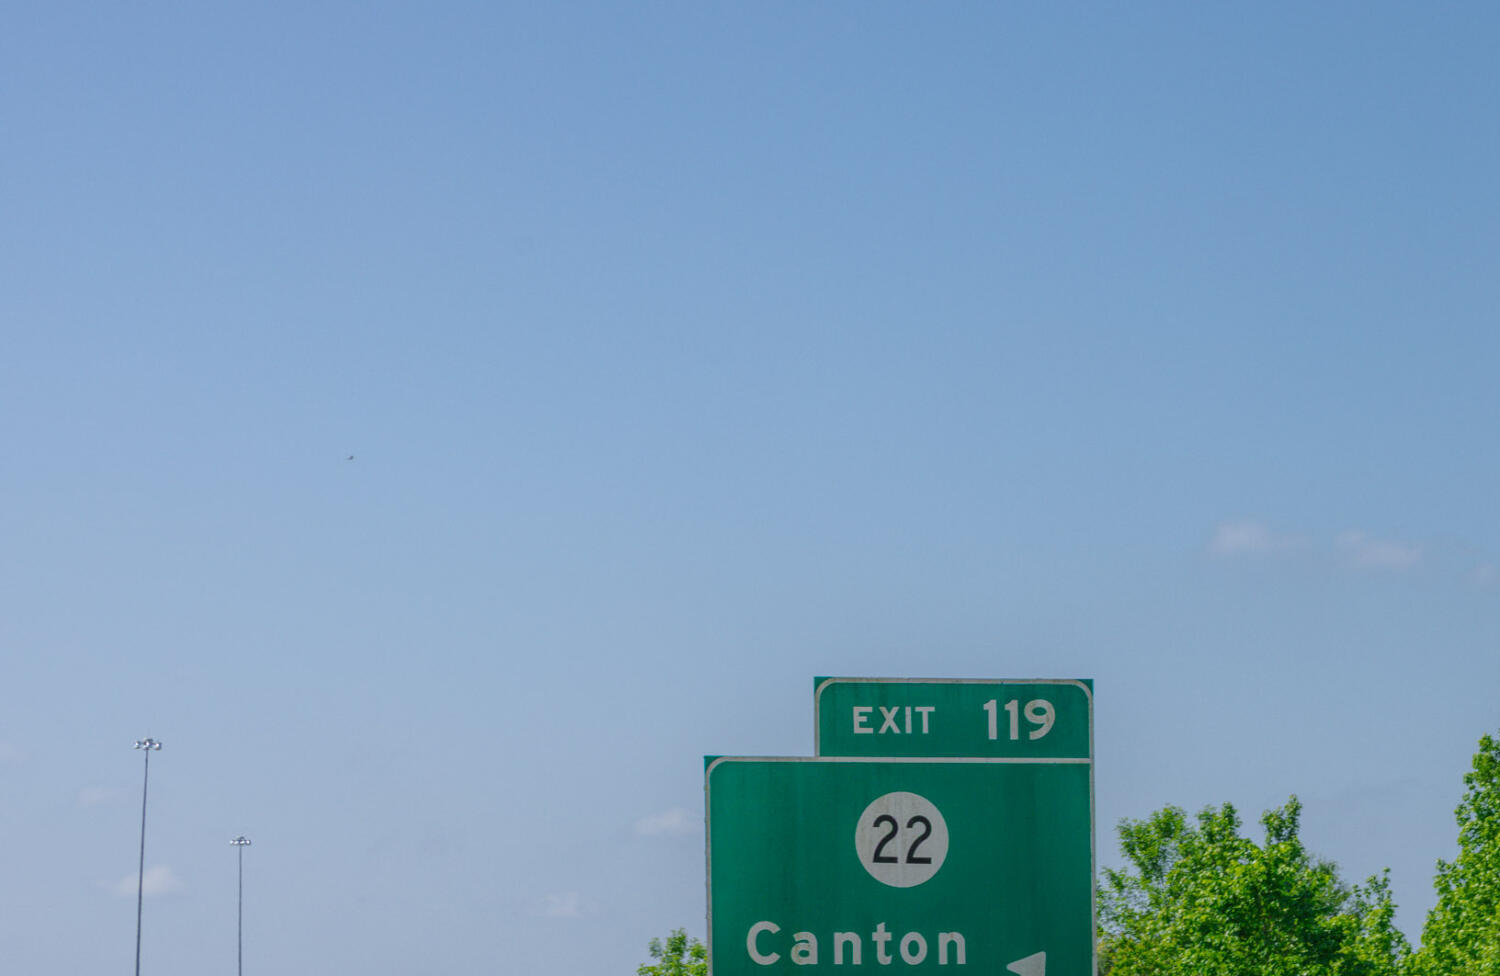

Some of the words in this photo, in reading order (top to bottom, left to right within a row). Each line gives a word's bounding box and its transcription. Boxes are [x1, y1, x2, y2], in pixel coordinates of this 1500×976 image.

[852, 706, 935, 734] EXIT
[983, 699, 1056, 740] 119
[872, 814, 932, 865] 22
[746, 920, 966, 966] Canton
